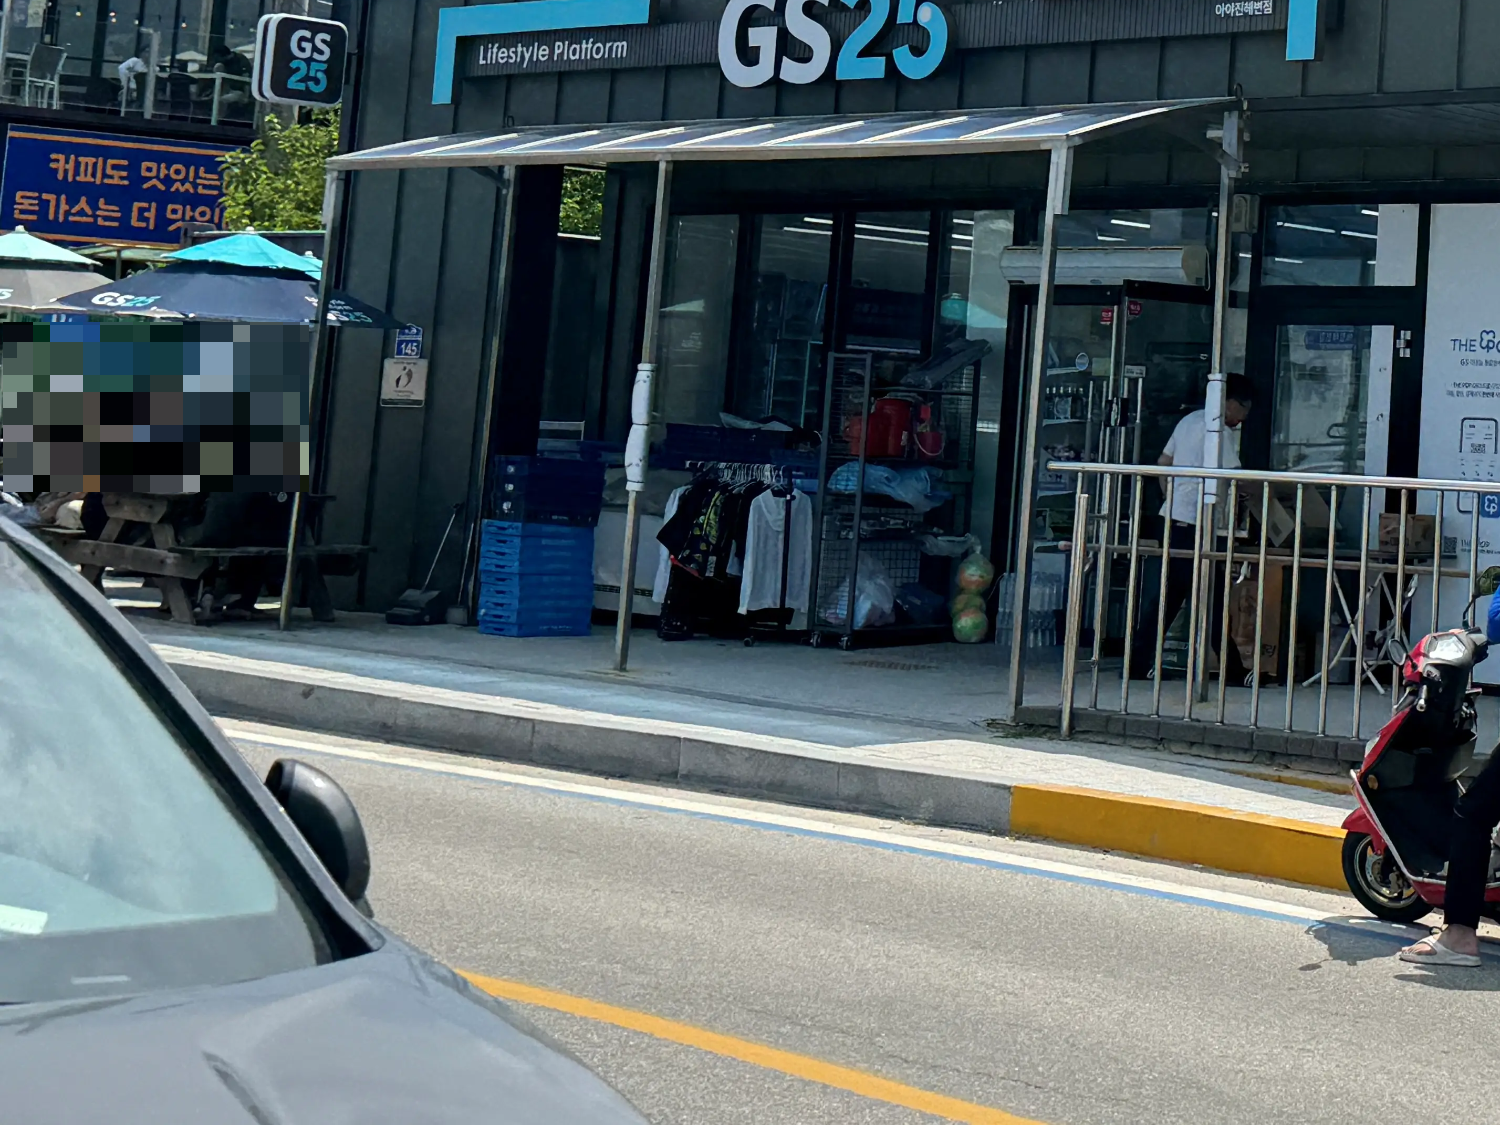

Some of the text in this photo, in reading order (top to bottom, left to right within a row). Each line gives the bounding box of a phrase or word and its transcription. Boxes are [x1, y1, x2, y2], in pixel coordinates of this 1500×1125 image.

[290, 29, 331, 61] GS
[479, 38, 628, 68] Lifestyle Platform
[287, 59, 328, 93] 25
[50, 154, 129, 185] 커피도
[14, 191, 121, 227] 돈가스는
[131, 202, 157, 230] 더
[91, 291, 160, 306] GS25
[401, 342, 417, 355] 145
[1450, 339, 1477, 352] THE
